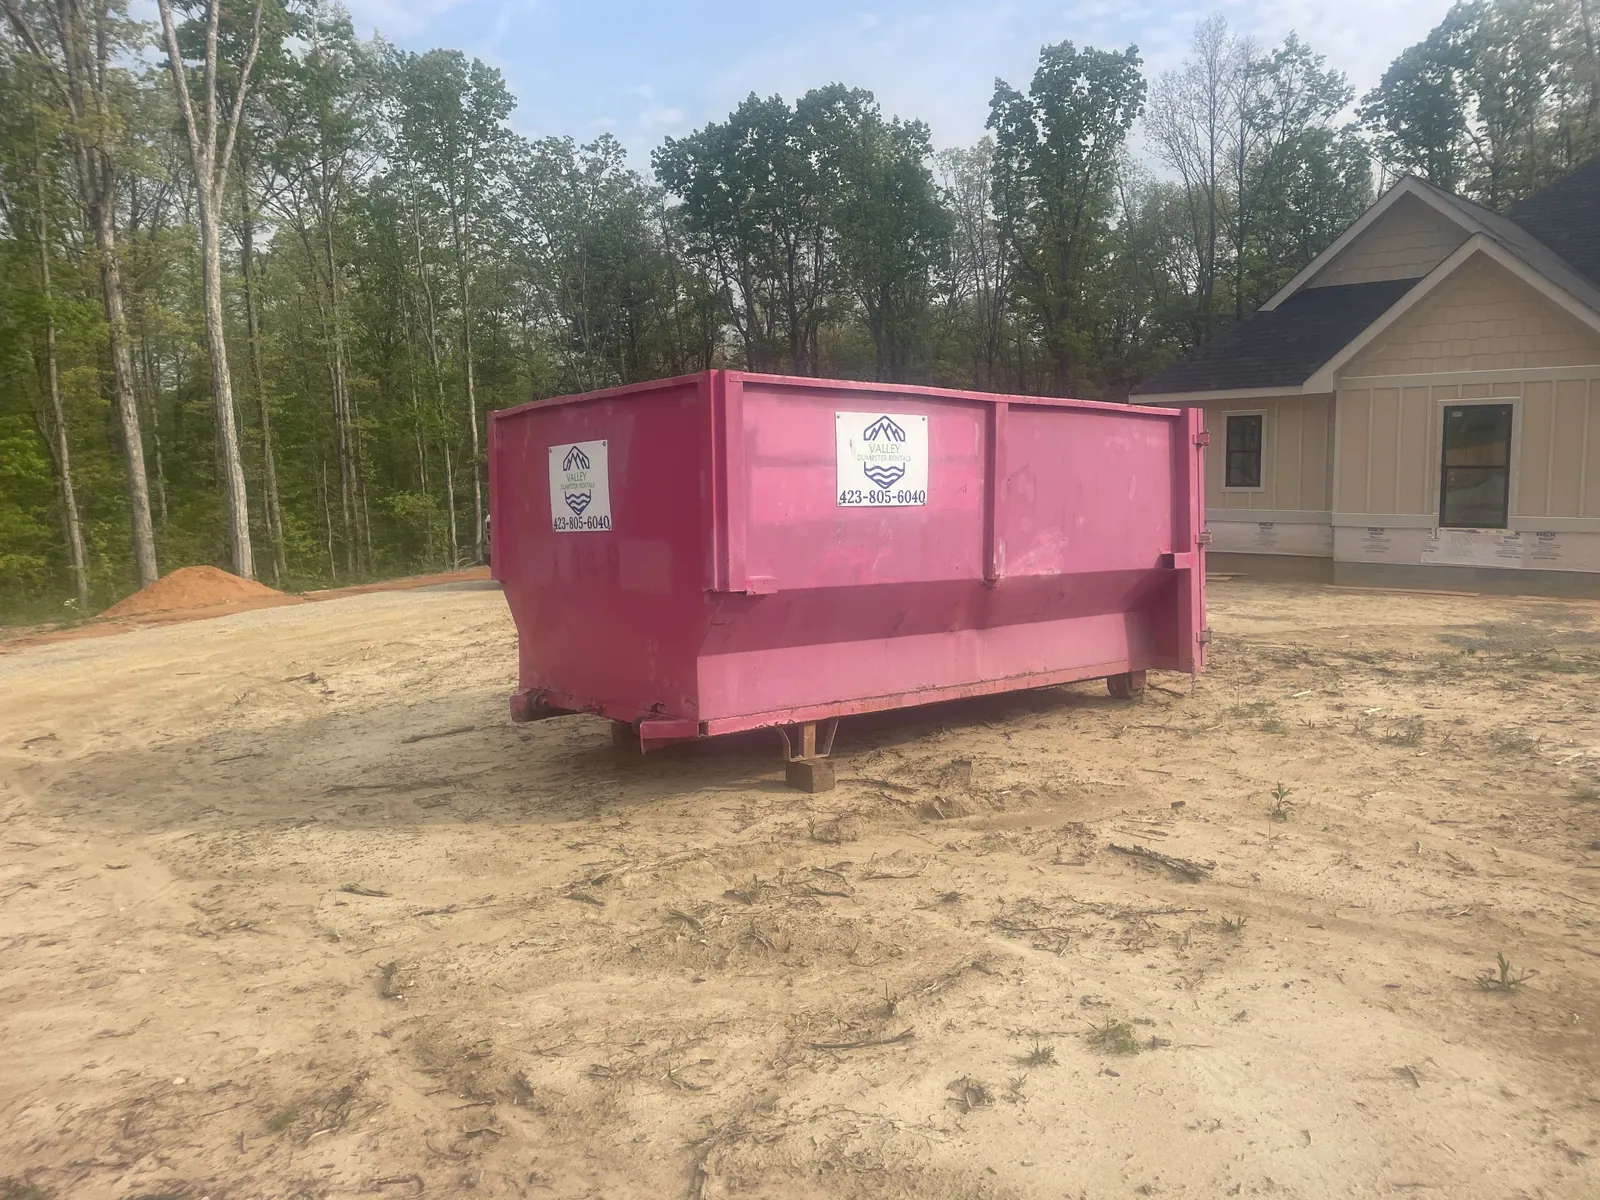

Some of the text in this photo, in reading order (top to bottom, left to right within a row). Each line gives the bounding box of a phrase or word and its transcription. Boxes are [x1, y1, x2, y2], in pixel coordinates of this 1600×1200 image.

[869, 443, 900, 454] VALLEY
[566, 471, 587, 482] VALLEY
[840, 489, 926, 504] 423-805-6040
[553, 515, 610, 530] 423-805-6040
